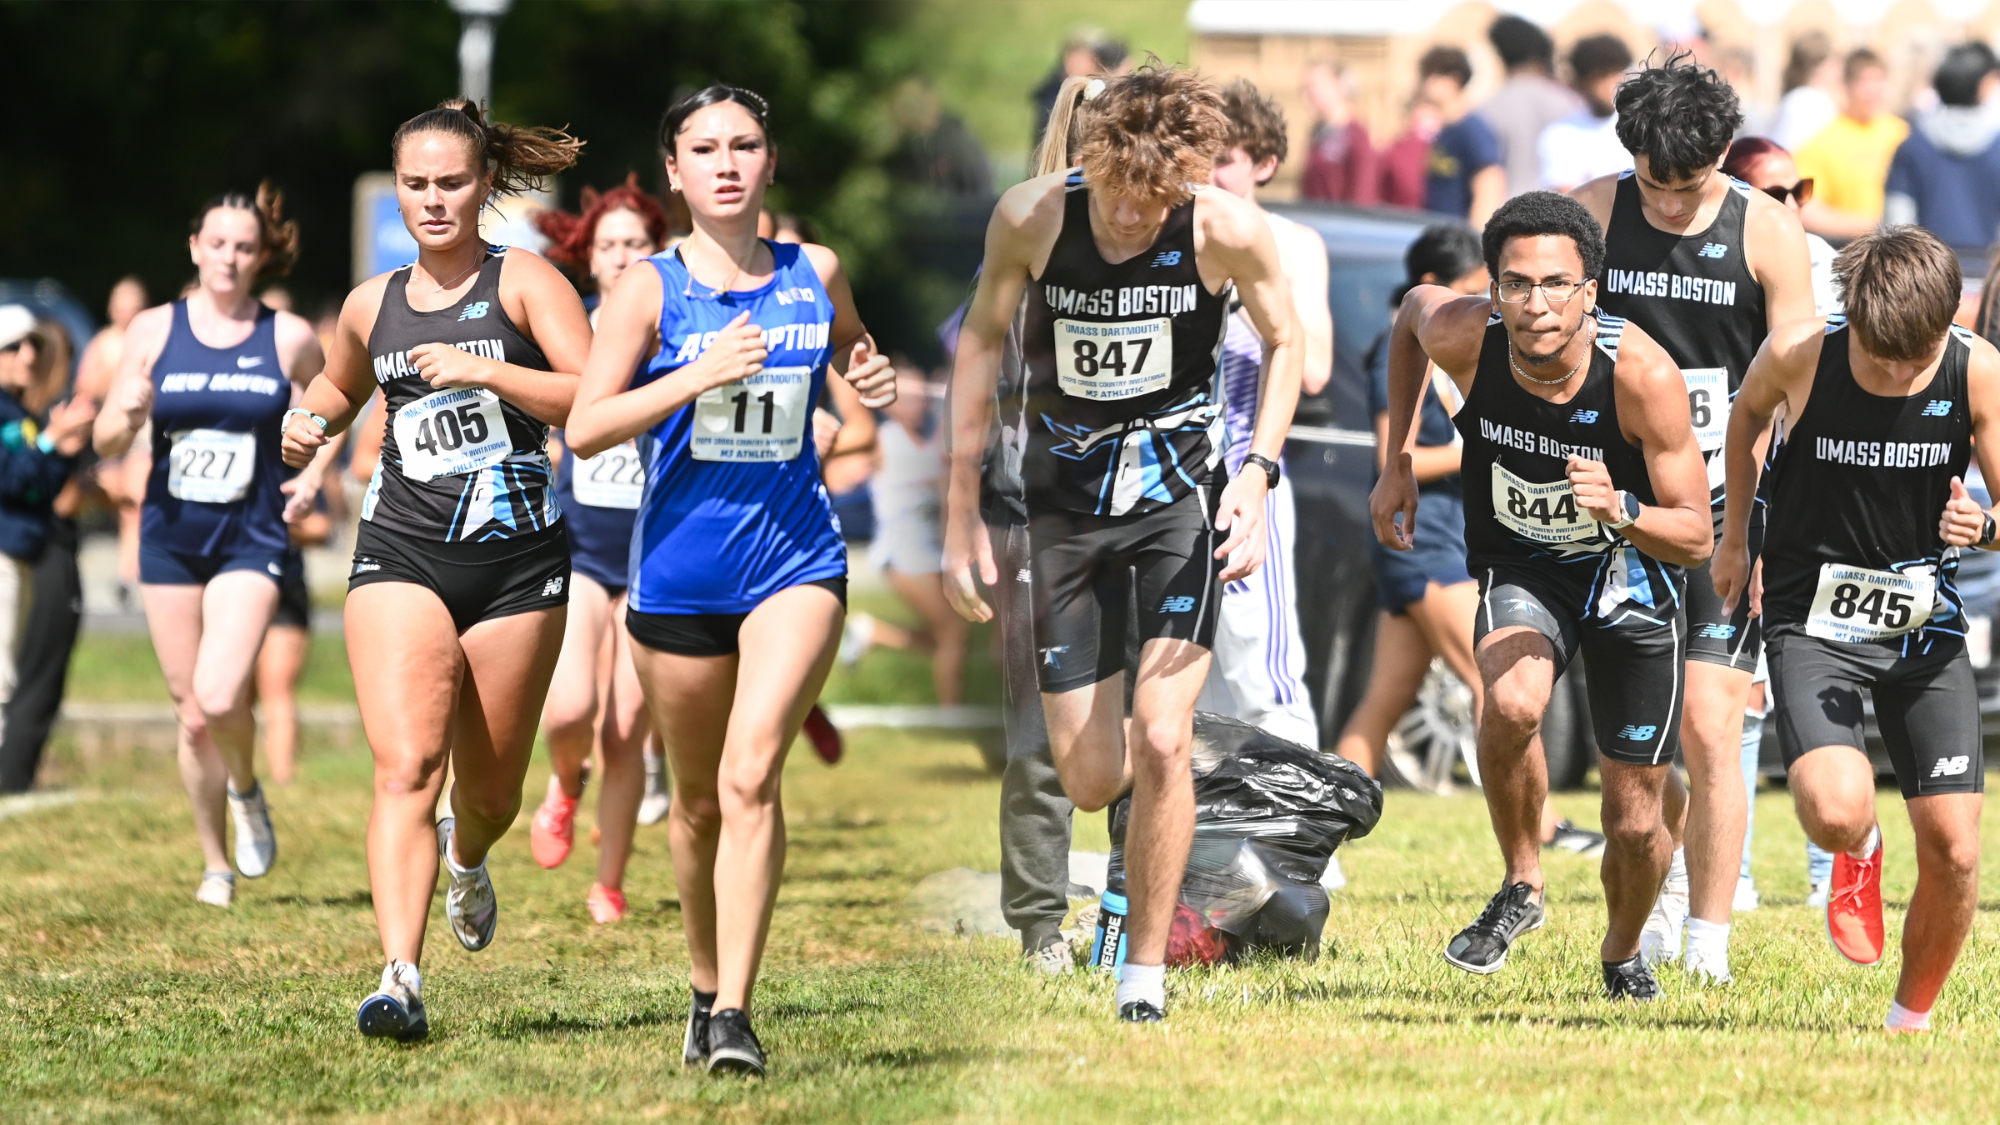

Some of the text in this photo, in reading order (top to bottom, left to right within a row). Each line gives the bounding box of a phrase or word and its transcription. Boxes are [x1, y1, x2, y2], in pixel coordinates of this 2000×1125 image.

[1045, 284, 1197, 317] UMASS BOSTON
[1607, 268, 1736, 306] UMASS BOSTON
[674, 321, 830, 363] ASPTION
[1065, 323, 1160, 337] UMASS DARTMOUTH
[373, 350, 421, 384] UMA
[1073, 337, 1153, 378] 847
[160, 372, 210, 394] NEW
[746, 374, 803, 385] DARTMOUTH
[1077, 379, 1097, 388] CROSS
[1099, 380, 1126, 388] COUNTRY
[1128, 372, 1166, 385] INVITATIONAL
[1100, 386, 1144, 398] ATHLETIC
[1685, 374, 1718, 384] MOUTH
[731, 391, 774, 434] 11
[415, 402, 489, 457] 405
[1480, 417, 1535, 453] UMASS
[469, 440, 507, 457] INVITATIONAL
[736, 449, 779, 459] ATHLETIC
[1816, 436, 1952, 468] UMASS BOSTON
[180, 448, 236, 480] 227
[590, 453, 645, 486] 222
[1500, 470, 1571, 495] UMASS DARTMOU
[1507, 486, 1579, 526] 844
[1511, 517, 1528, 528] CROSS
[1528, 524, 1554, 534] COUNTRY
[1555, 522, 1594, 534] INVITATIONAL
[1530, 532, 1572, 541] ATHLETIC
[1832, 569, 1925, 591] UMASS DARTMOUTH
[1830, 583, 1915, 629] 845
[1829, 621, 1850, 630] CROSS
[1850, 626, 1879, 636] COUNTRY
